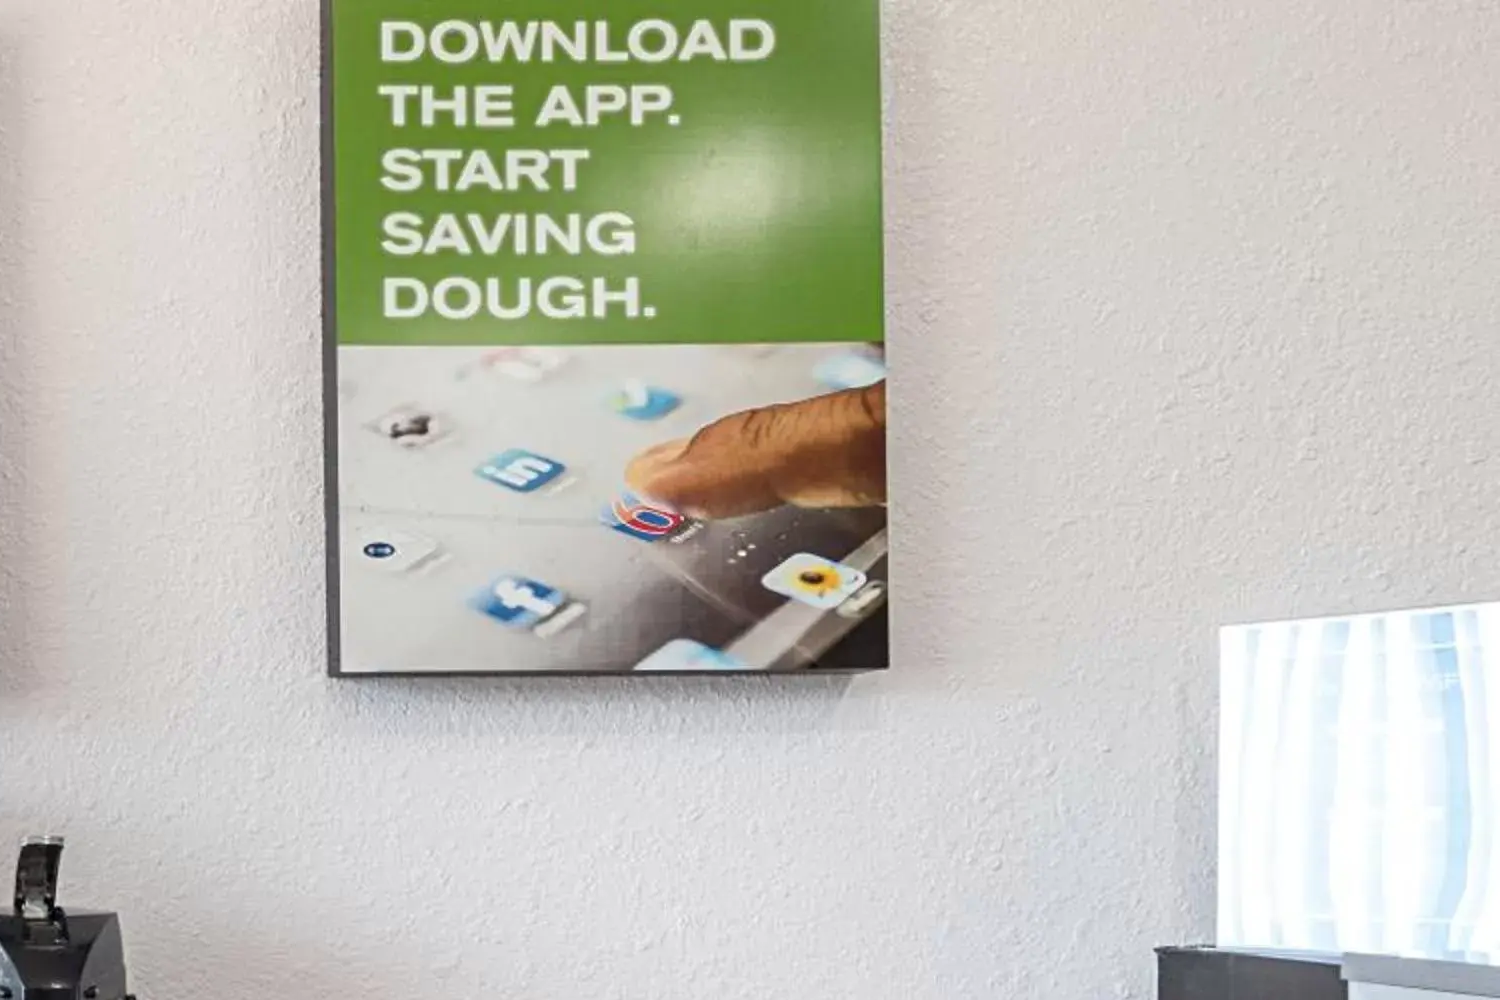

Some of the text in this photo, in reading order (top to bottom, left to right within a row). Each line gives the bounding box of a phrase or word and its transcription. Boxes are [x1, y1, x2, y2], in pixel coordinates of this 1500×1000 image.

[381, 19, 775, 62] DOWNLOAD
[379, 85, 680, 127] THE APP.
[380, 149, 590, 192] START
[381, 212, 636, 256] SAVING
[383, 276, 656, 319] DOUGH.
